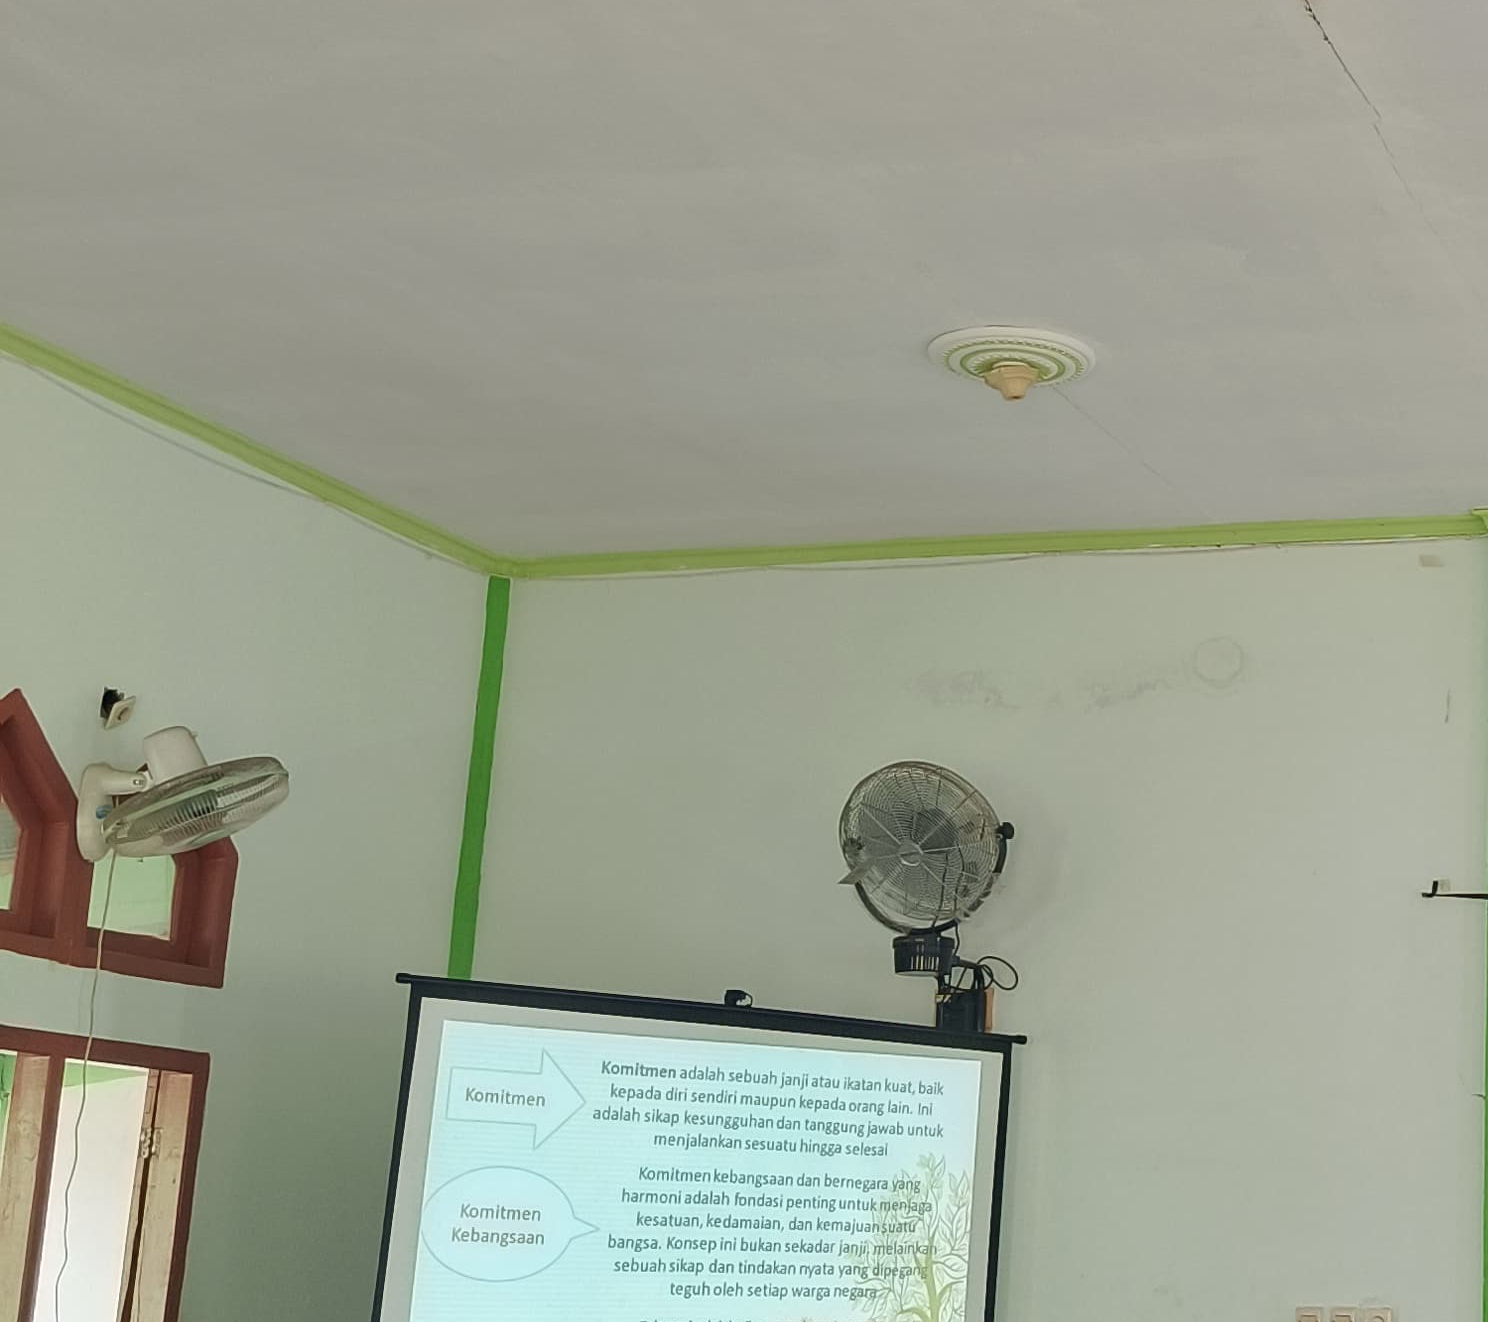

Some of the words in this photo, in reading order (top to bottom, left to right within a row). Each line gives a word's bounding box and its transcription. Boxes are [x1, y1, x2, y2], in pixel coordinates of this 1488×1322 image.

[601, 1061, 677, 1079] Komitmen
[680, 1066, 725, 1082] adalah
[728, 1069, 777, 1085] sebuah
[781, 1072, 808, 1090] janji
[811, 1075, 840, 1089] atau
[843, 1077, 881, 1092] ikatan
[884, 1079, 915, 1095] kuat,
[918, 1081, 944, 1096] baik
[465, 1087, 546, 1107] Komitmen
[610, 1083, 661, 1102] kepada
[665, 1087, 688, 1102] diri
[690, 1089, 737, 1105] sendiri
[740, 1094, 796, 1110] maupun
[799, 1095, 846, 1112] kepada
[849, 1102, 885, 1116] orang
[888, 1100, 913, 1115] lain.
[918, 1103, 933, 1116] Ini
[593, 1106, 640, 1122] adalah
[644, 1109, 680, 1127] sikap
[684, 1110, 774, 1130] kesungguhan
[777, 1116, 800, 1130] dan
[805, 1119, 865, 1138] tanggung
[867, 1121, 904, 1138] jawab
[907, 1124, 944, 1138] untuk
[654, 1133, 742, 1150] menjalankan
[745, 1138, 797, 1153] sesuatu
[800, 1138, 842, 1157] hingga
[845, 1142, 888, 1157] selesai
[639, 1166, 711, 1183] Komitmen
[713, 1168, 793, 1188] kebangsaan
[797, 1173, 820, 1187] dan
[824, 1173, 888, 1192] bernegara
[892, 1179, 921, 1194] yang
[460, 1202, 541, 1222] Komitmen
[621, 1188, 682, 1205] harmoni
[684, 1190, 730, 1206] adalah
[734, 1192, 783, 1208] fondasi
[786, 1196, 836, 1212] penting
[839, 1198, 877, 1212] untuk
[636, 1211, 703, 1229] kesatuan,
[706, 1213, 785, 1232] kedamaian,
[789, 1217, 812, 1231] dan
[816, 1217, 880, 1235] kemajuan
[882, 1221, 916, 1234] suatu
[451, 1227, 545, 1247] Kebangsaan
[608, 1233, 662, 1253] bangsa.
[666, 1236, 717, 1253] Konsep
[720, 1237, 736, 1252] ini
[740, 1237, 781, 1252] bukan
[784, 1239, 836, 1253] sekadar
[613, 1257, 666, 1273] sebuah
[668, 1258, 704, 1276] sikap
[708, 1259, 735, 1274] dan
[738, 1259, 796, 1275] tindakan
[800, 1262, 834, 1278] nyata
[838, 1265, 868, 1279] yang
[670, 1281, 710, 1299] teguh
[713, 1282, 743, 1297] oleh
[747, 1282, 788, 1300] setiap
[791, 1286, 830, 1301] warga
[833, 1286, 877, 1300] negara
